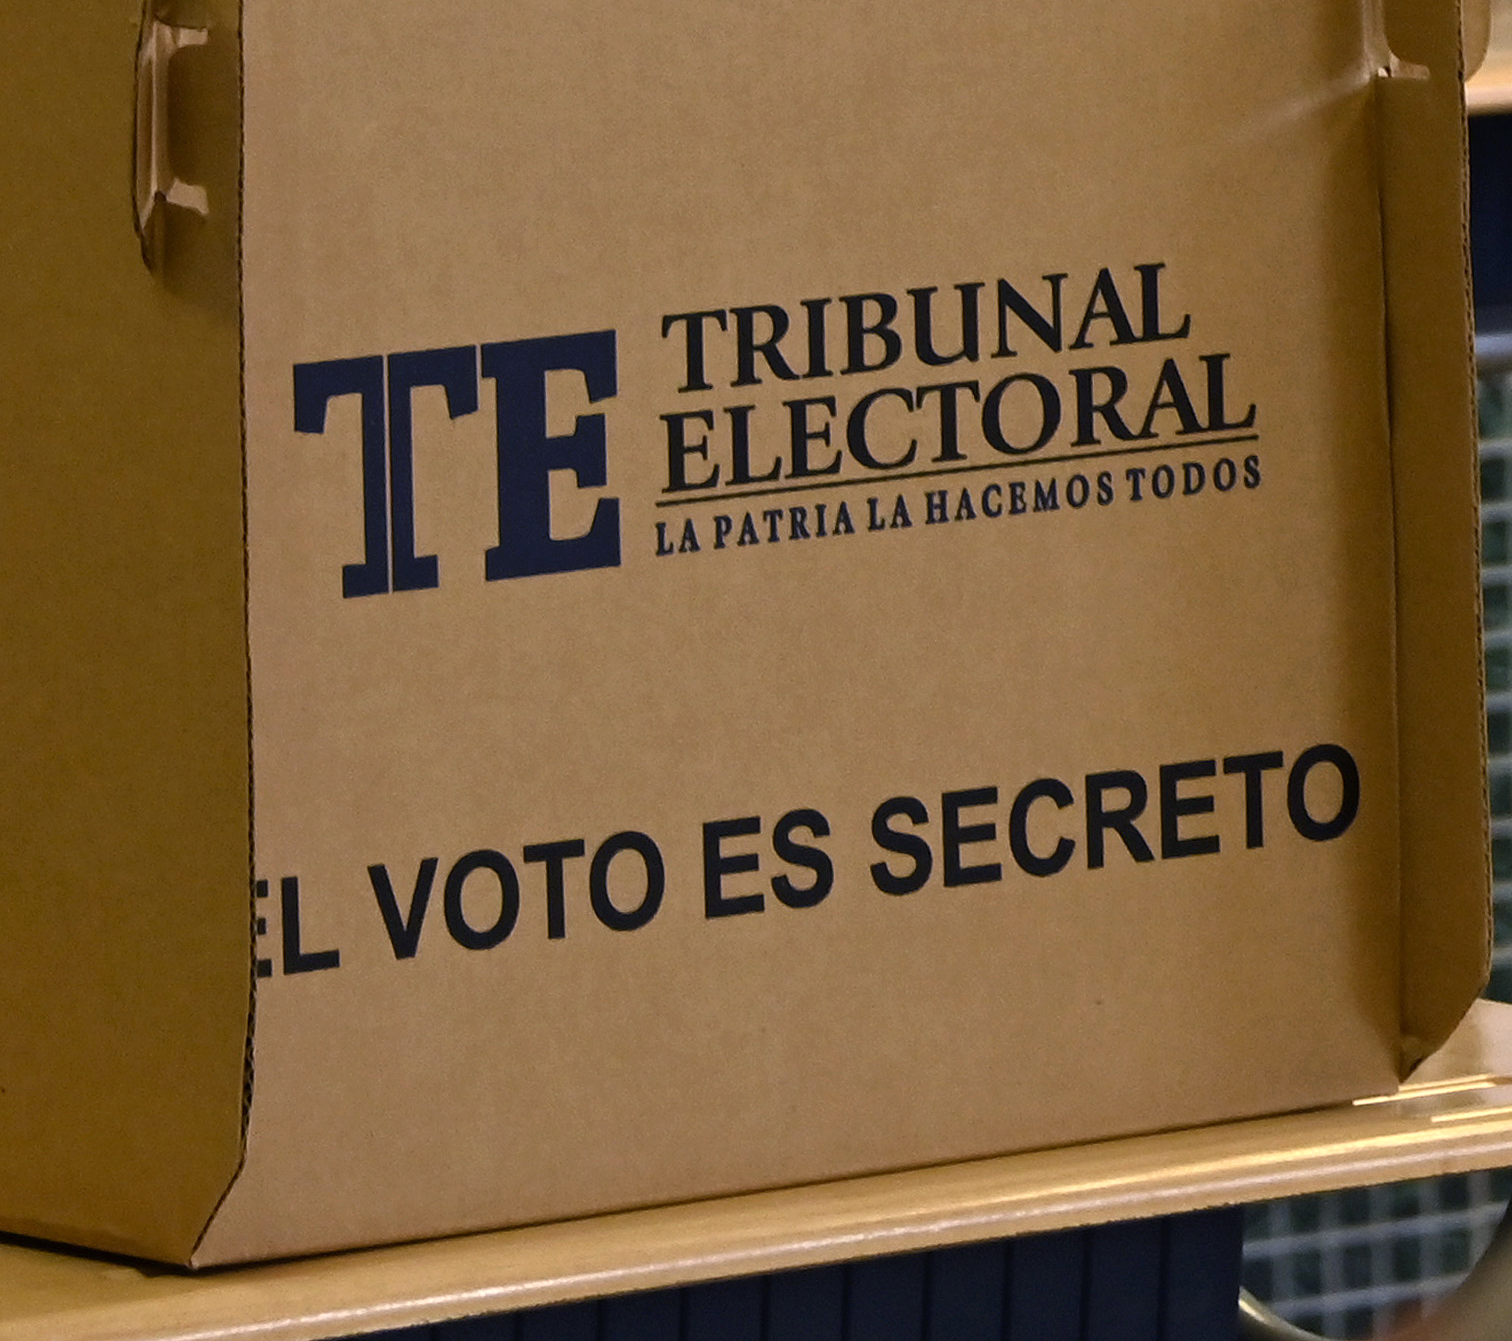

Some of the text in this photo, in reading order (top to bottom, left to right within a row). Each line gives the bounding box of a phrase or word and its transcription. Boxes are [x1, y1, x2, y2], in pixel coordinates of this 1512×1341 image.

[661, 262, 1191, 393] TRIBUNAL
[292, 329, 622, 599] TE
[659, 352, 1257, 494] ELECTORAL
[655, 454, 1262, 557] LA PATRIA LA HACEMOS TODOS
[256, 742, 1363, 979] L VOTO ES SECRETO
